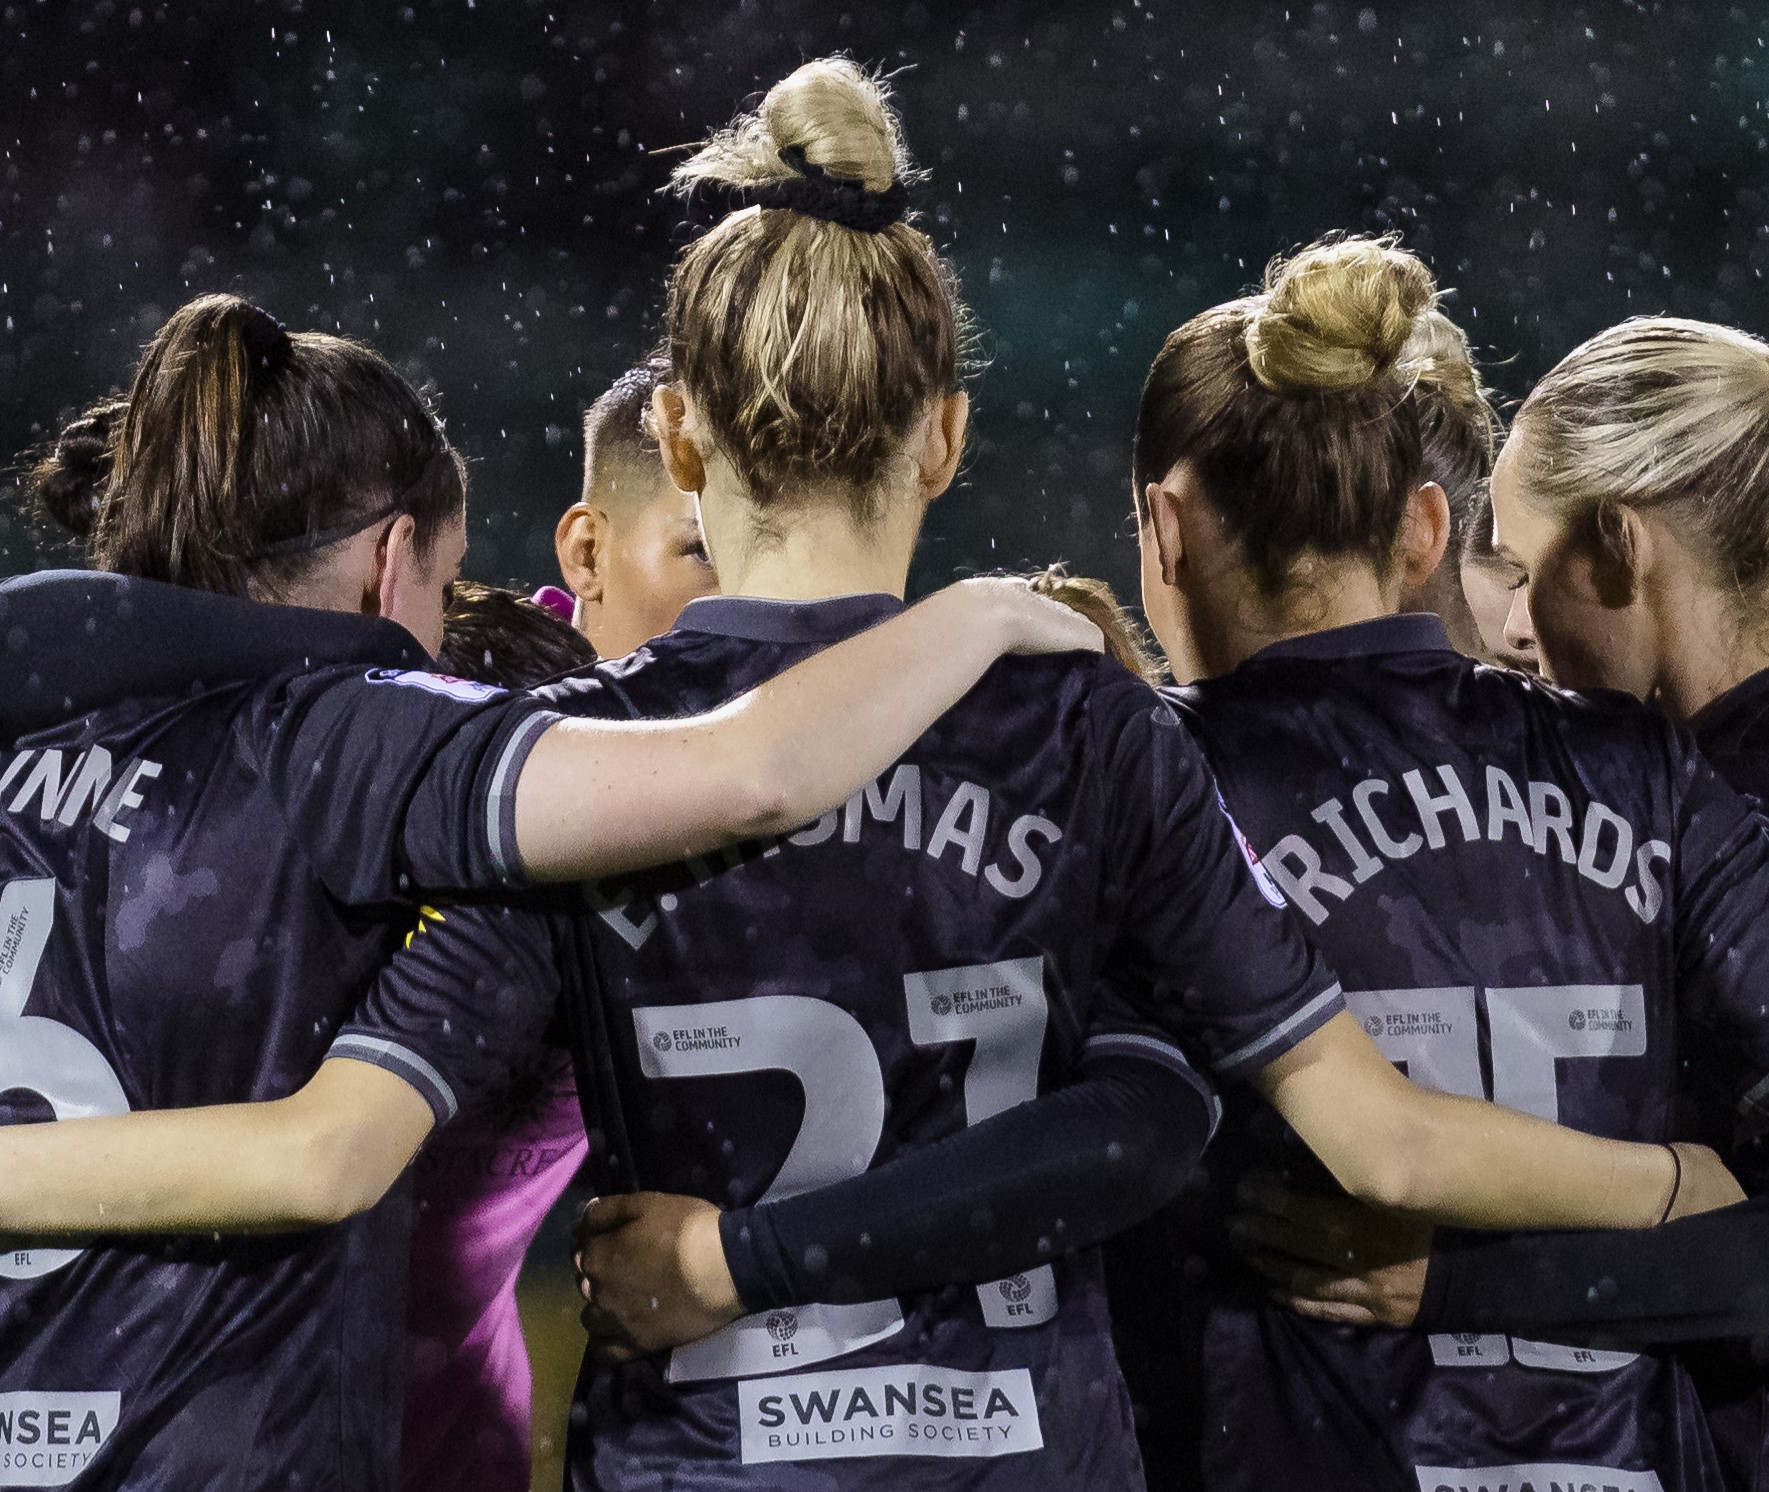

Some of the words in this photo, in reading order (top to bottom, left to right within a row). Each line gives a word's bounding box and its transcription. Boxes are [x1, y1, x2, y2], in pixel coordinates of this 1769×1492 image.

[1262, 764, 1671, 926] RICHARDS
[7, 913, 19, 936] THE
[2, 906, 30, 975] COMMUNITY
[3, 936, 14, 950] IN
[953, 991, 973, 1003] EFL
[975, 988, 988, 1000] IN
[990, 985, 1010, 998] THE
[955, 994, 1022, 1014] COMMUNITY
[1386, 1014, 1406, 1025] EFL
[1407, 1013, 1419, 1025] IN
[1421, 1012, 1441, 1023] THE
[673, 1030, 692, 1041] EFL
[694, 1028, 706, 1039] IN
[707, 1026, 728, 1038] THE
[1387, 1022, 1452, 1036] COMMUNITY
[675, 1037, 741, 1051] COMMUNITY
[634, 956, 1057, 1382] 21
[14, 1252, 32, 1266] EFL
[1007, 1303, 1033, 1316] EFL
[772, 1343, 799, 1358] EFL
[1457, 1345, 1483, 1357] EFL
[1573, 1351, 1597, 1363] EFL
[758, 1382, 1020, 1428] SWANSEA
[768, 1424, 895, 1447] BUILDING
[908, 1423, 1012, 1441] SOCIETY
[3, 1452, 91, 1468] SOCIETY
